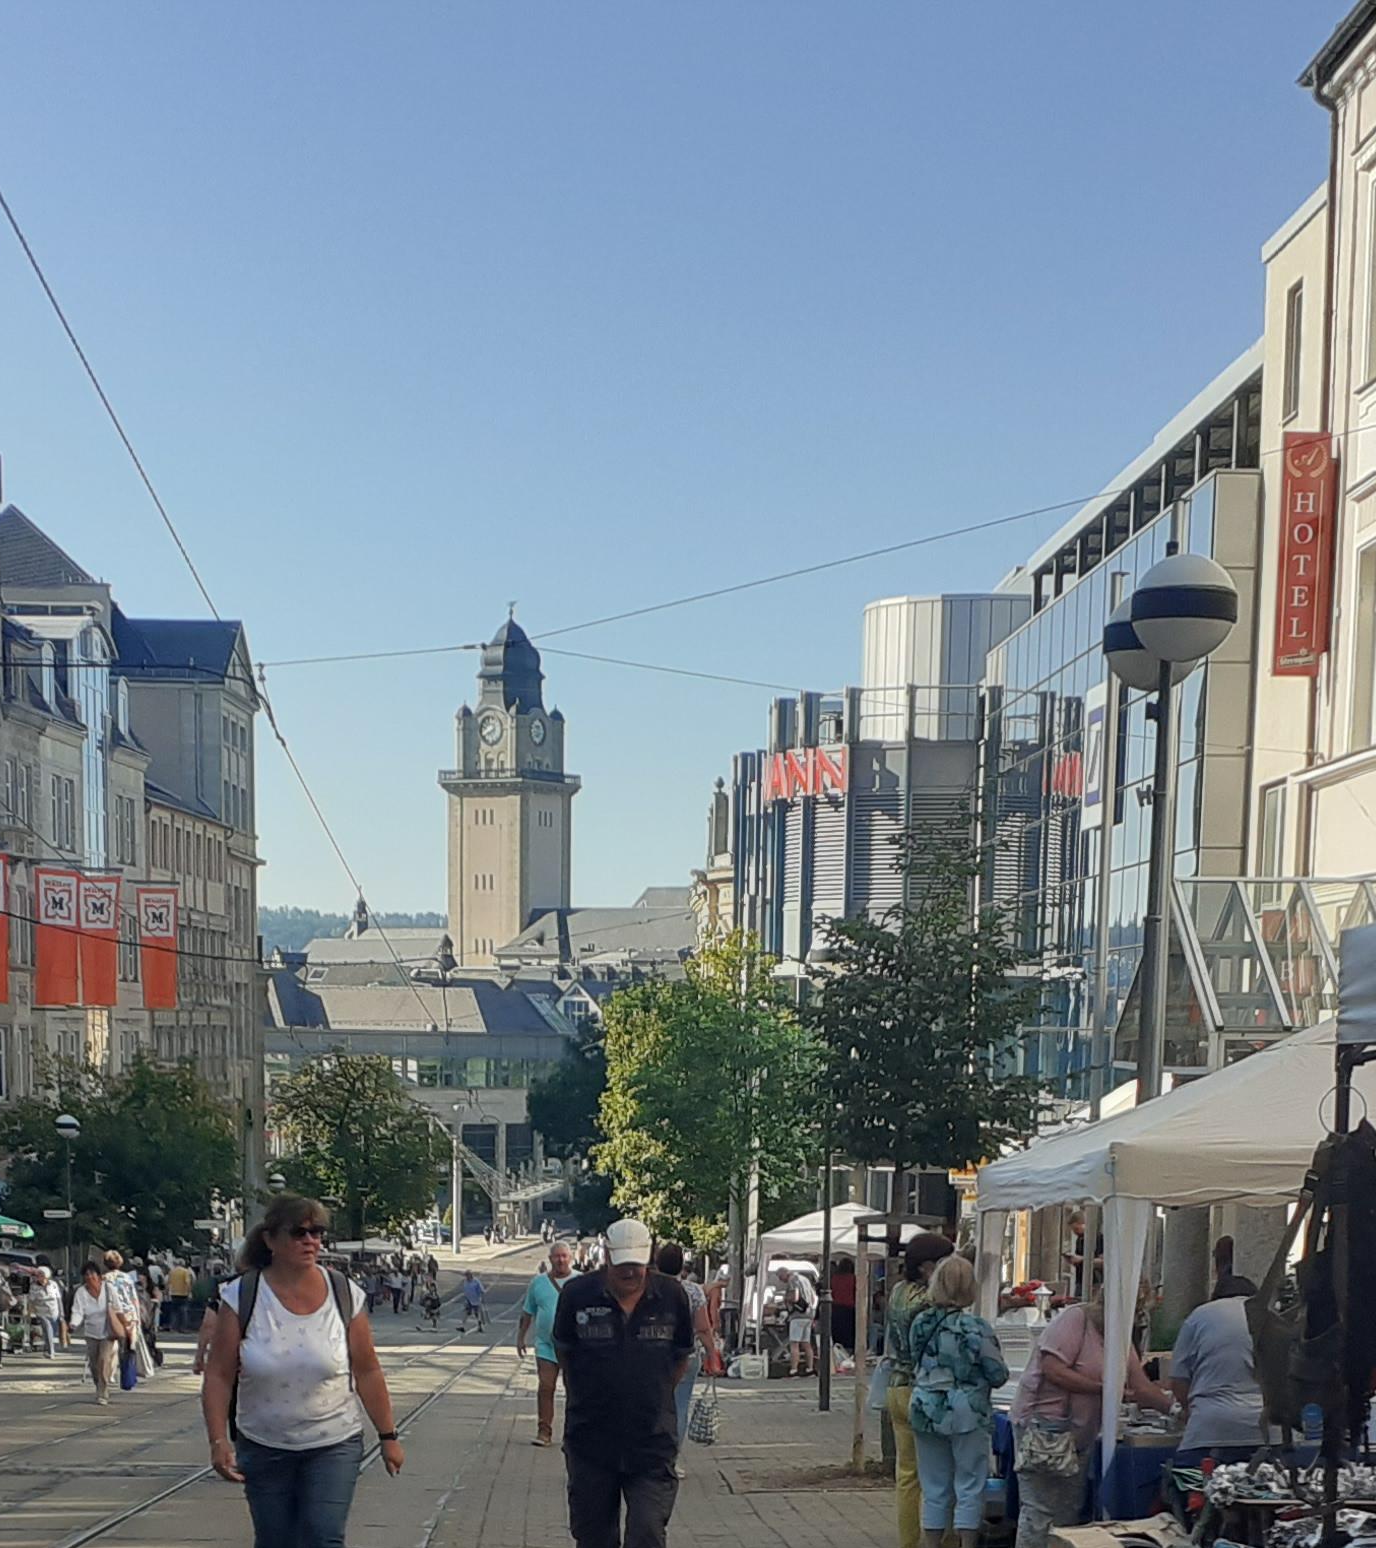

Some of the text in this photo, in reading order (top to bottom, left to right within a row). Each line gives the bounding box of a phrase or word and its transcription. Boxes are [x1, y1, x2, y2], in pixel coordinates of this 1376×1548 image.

[1289, 491, 1315, 638] HOTEL
[51, 896, 64, 911] M
[91, 902, 105, 915] M
[152, 912, 163, 924] M
